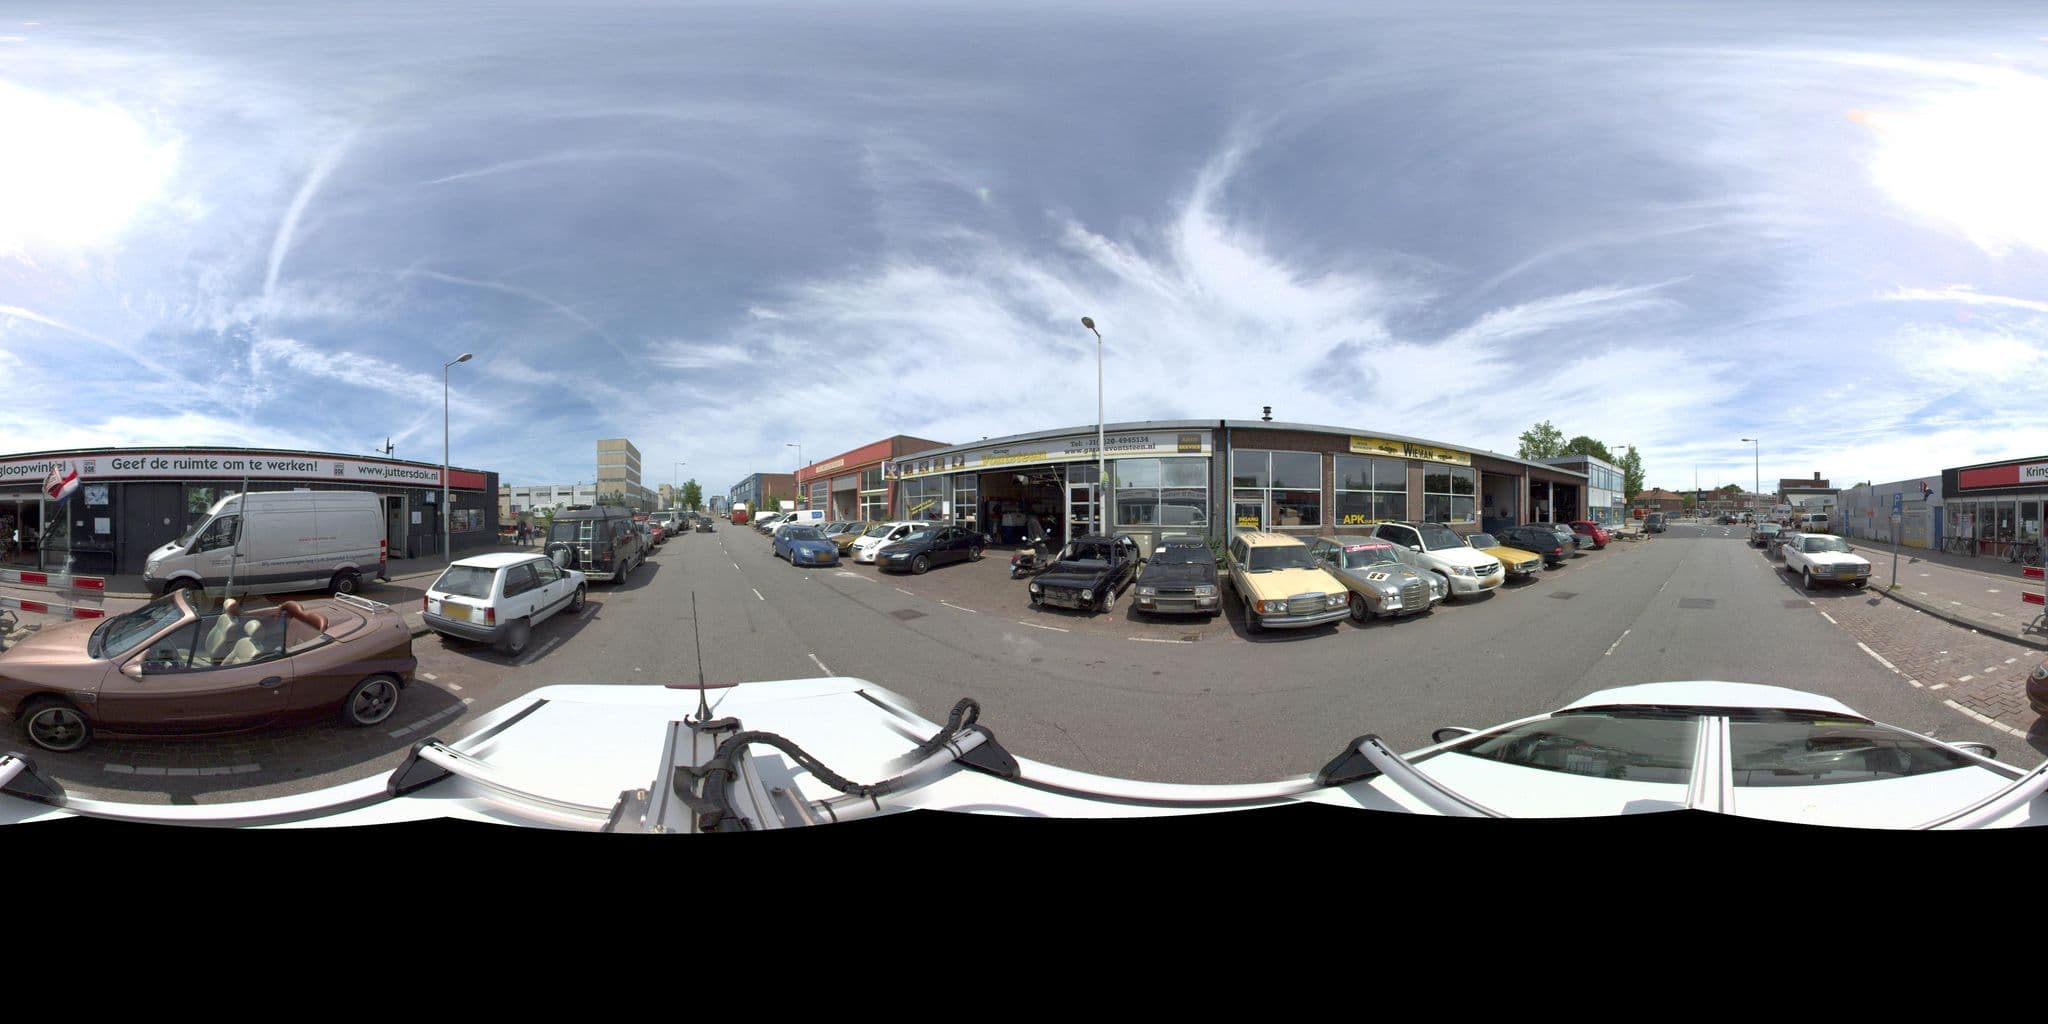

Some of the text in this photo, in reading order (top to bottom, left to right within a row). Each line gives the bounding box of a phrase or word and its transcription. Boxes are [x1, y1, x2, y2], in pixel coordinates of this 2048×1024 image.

[112, 457, 318, 472] Geef de ruimte om te werken!
[358, 465, 438, 481] www.juttersdok.nl
[1343, 514, 1365, 524] APK
